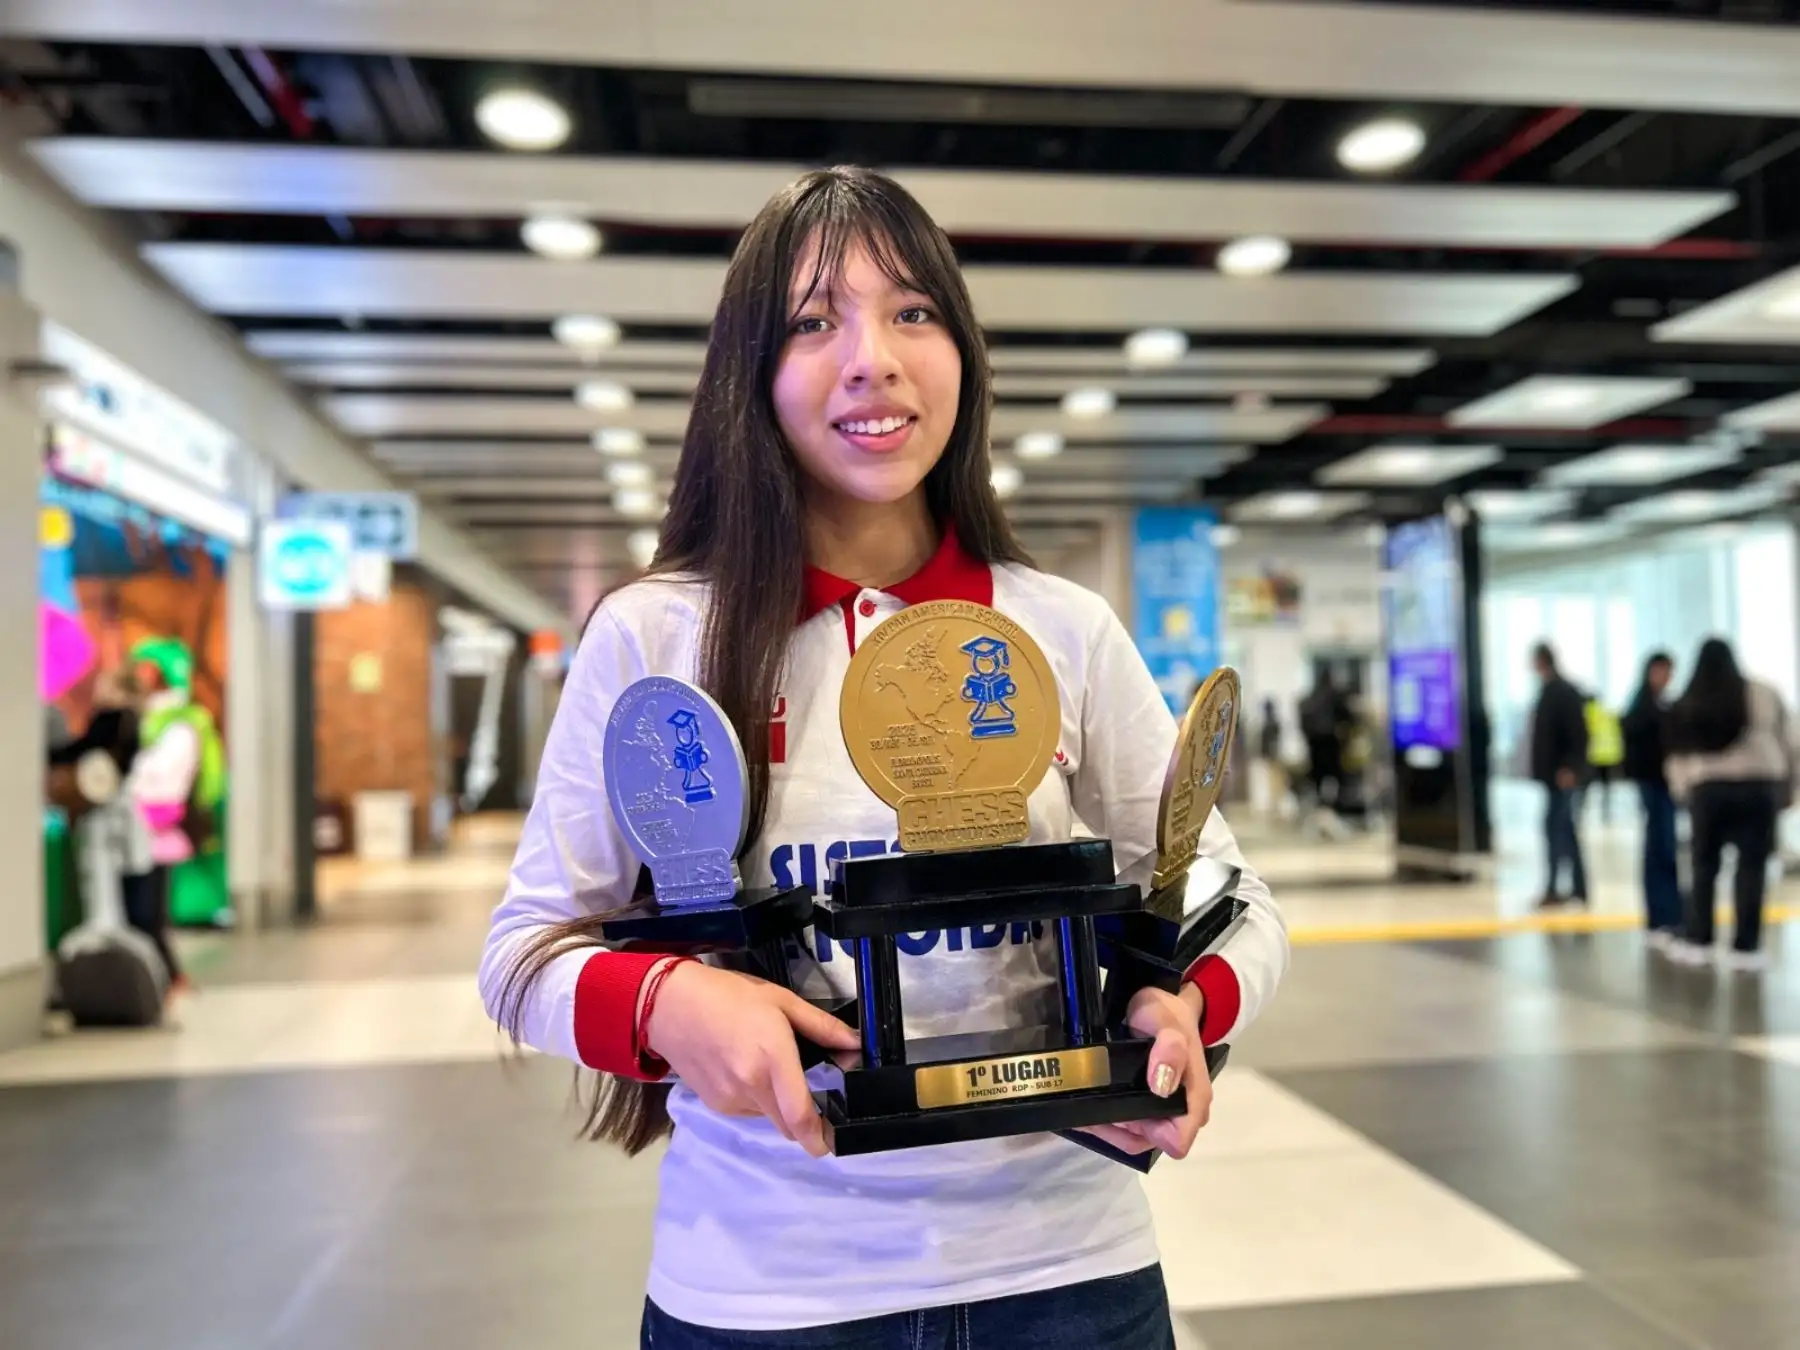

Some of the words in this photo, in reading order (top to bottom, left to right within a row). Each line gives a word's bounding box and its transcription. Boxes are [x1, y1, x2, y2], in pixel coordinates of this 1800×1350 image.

[912, 603, 975, 620] AMERICAN
[976, 607, 1019, 641] SCHOOL
[902, 791, 1024, 831] CHESS
[992, 1057, 1061, 1084] LUGAR
[966, 1087, 1008, 1098] FEMININO
[1035, 1081, 1053, 1090] SUB
[1054, 1080, 1063, 1088] 17
